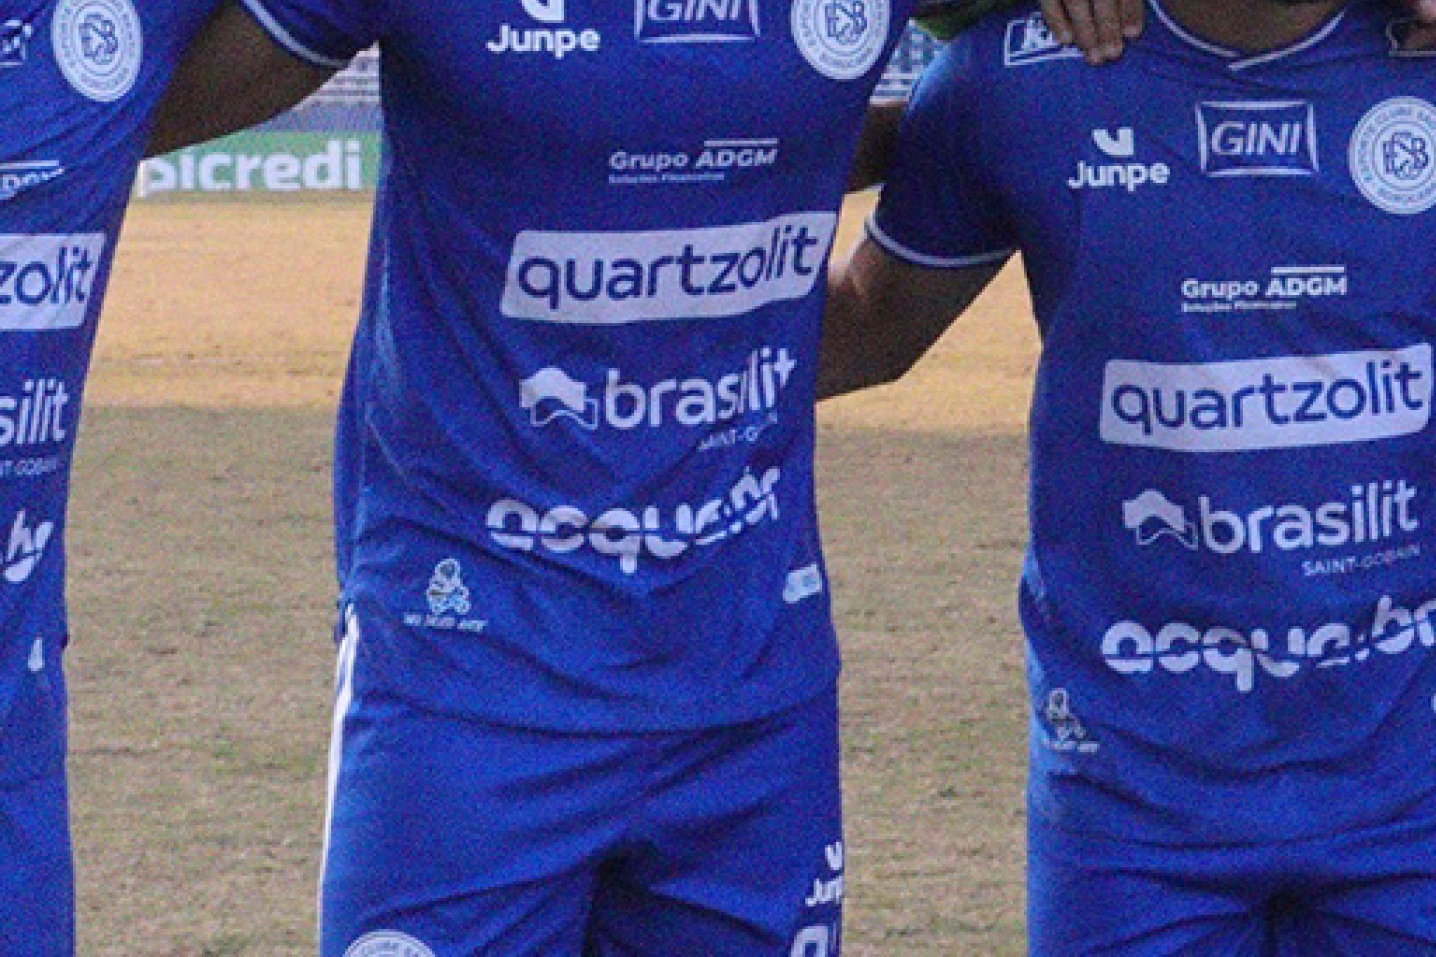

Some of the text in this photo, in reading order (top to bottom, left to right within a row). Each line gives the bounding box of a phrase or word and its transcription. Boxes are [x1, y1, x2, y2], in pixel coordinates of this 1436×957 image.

[487, 23, 601, 58] Junpe
[1210, 121, 1302, 157] GINI
[608, 148, 778, 174] Grupo ADGM
[1068, 161, 1170, 192] Junpe
[518, 225, 819, 309] quartzolit
[1182, 276, 1348, 302] Grupo ADGM
[604, 347, 796, 430] brasilit
[1111, 360, 1423, 435] quartzolit
[1199, 479, 1419, 554] brasilit
